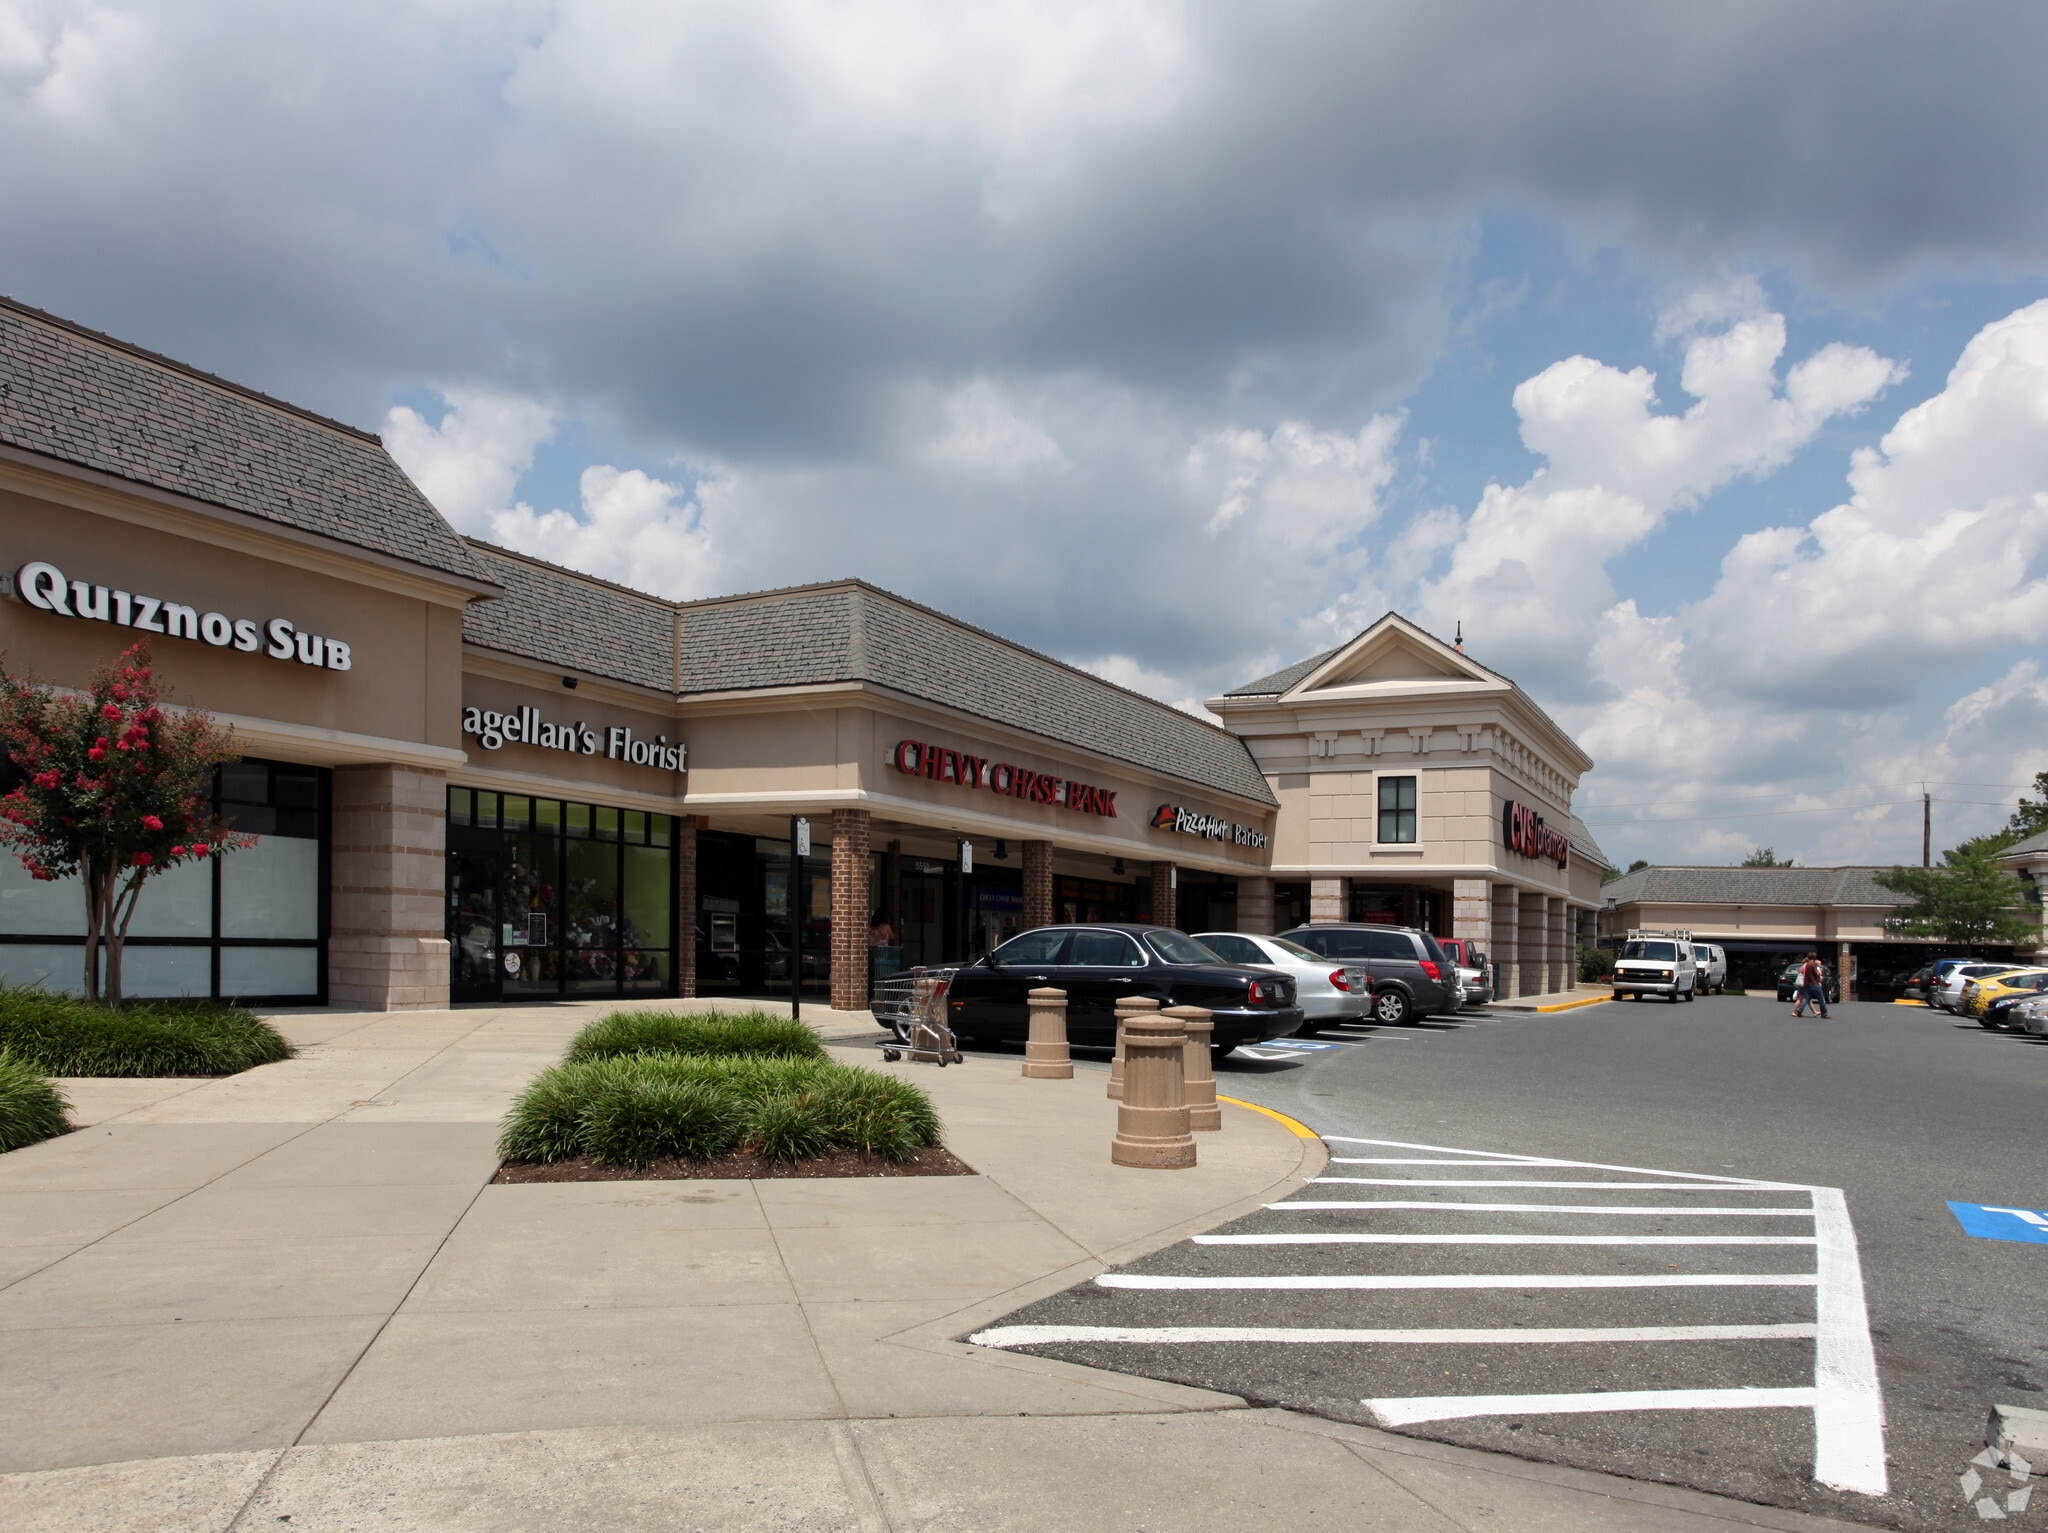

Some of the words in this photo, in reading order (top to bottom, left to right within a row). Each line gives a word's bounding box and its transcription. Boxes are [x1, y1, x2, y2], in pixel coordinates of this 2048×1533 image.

[462, 706, 596, 755] agellan's
[604, 726, 687, 773] Florist
[894, 740, 988, 789] CHEVY
[990, 763, 1062, 807] CHASE
[1065, 780, 1118, 818] BANK
[1234, 824, 1268, 849] Barber
